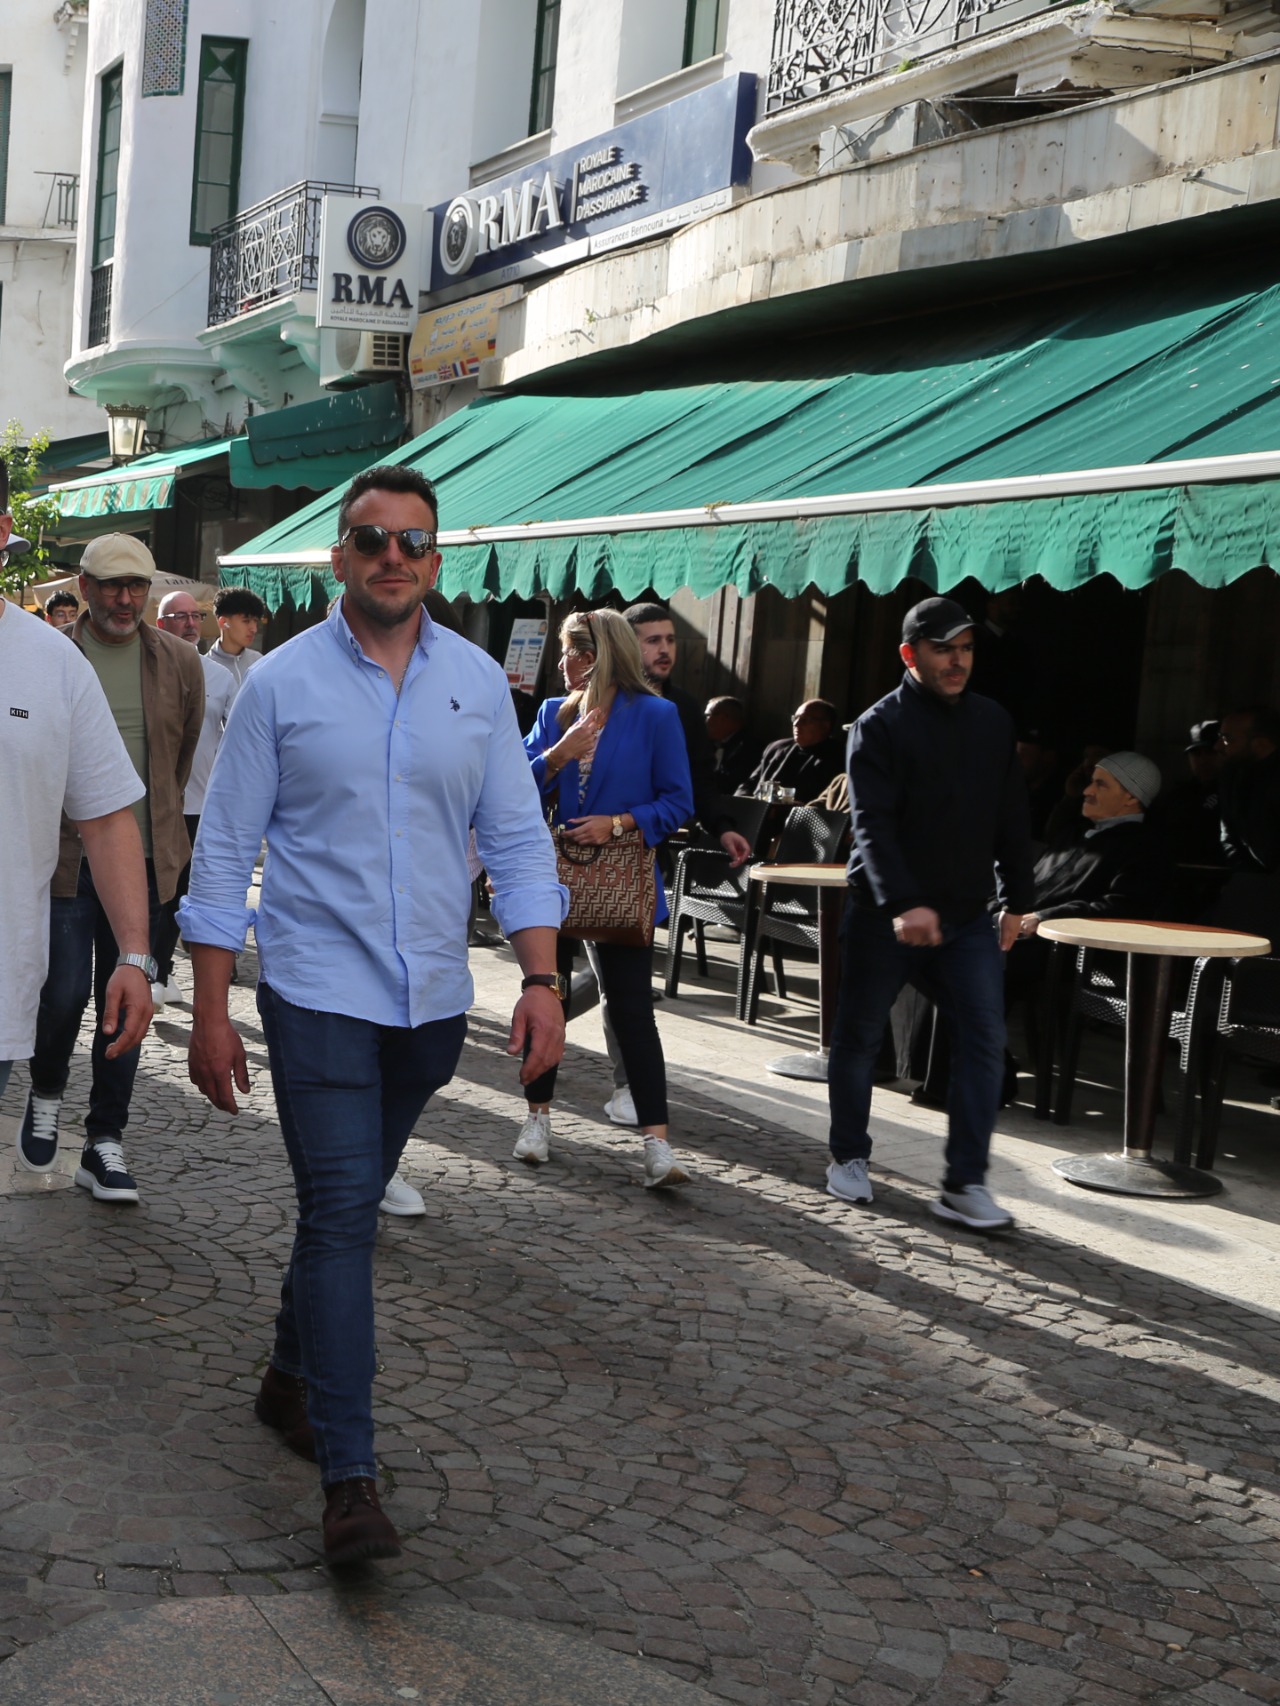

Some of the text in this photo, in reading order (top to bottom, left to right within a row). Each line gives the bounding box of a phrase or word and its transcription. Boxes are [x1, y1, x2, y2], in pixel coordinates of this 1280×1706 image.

[580, 146, 616, 173] ROYALE
[578, 161, 635, 197] MAROCAINE
[475, 171, 563, 256] RMA
[576, 182, 642, 221] D'ASSURANCE
[594, 218, 664, 249] Assurances Bennouna
[331, 273, 413, 308] RMA
[11, 709, 28, 718] KITH
